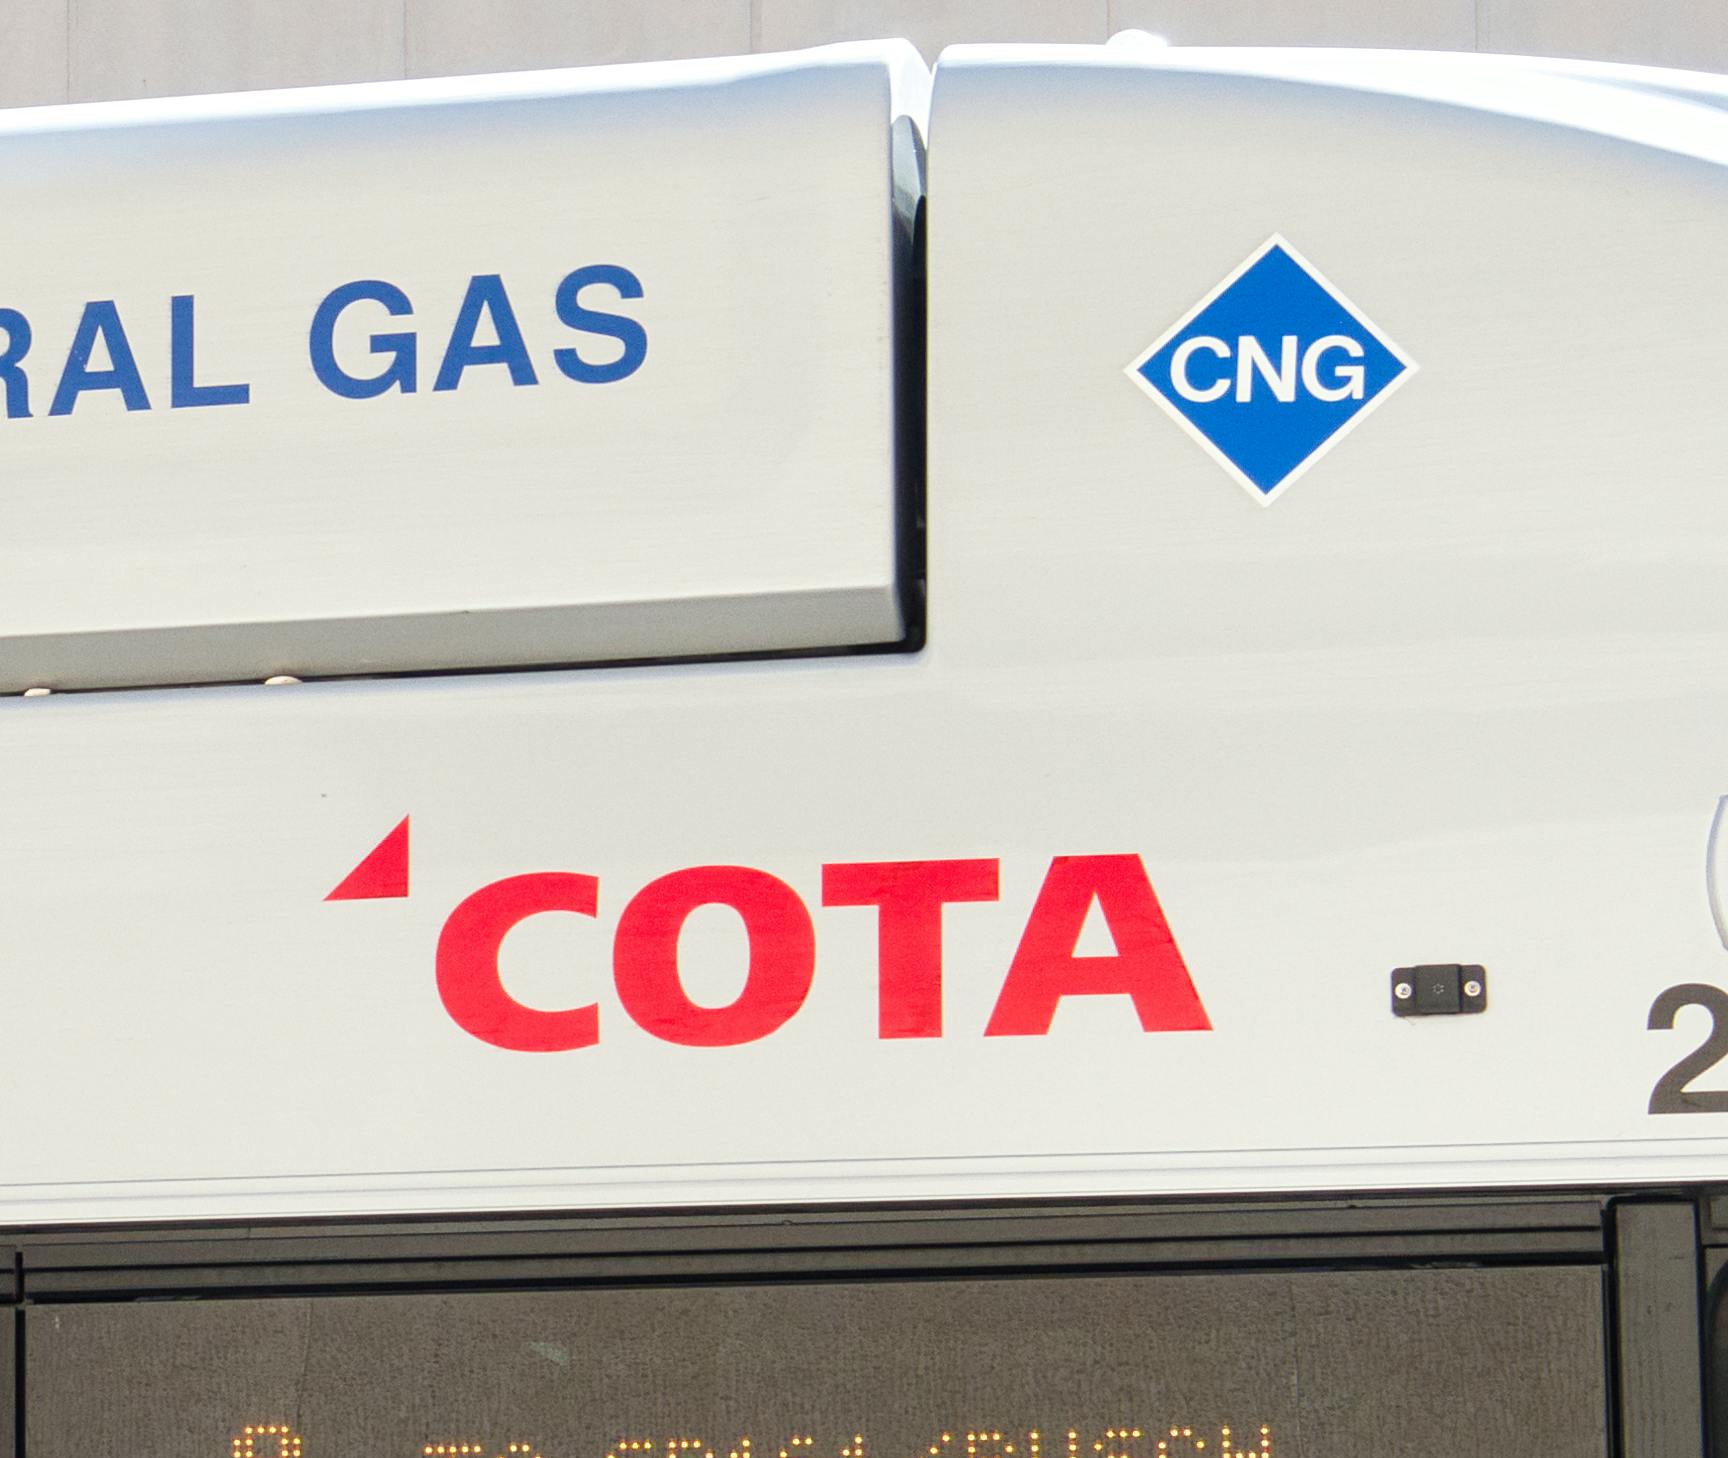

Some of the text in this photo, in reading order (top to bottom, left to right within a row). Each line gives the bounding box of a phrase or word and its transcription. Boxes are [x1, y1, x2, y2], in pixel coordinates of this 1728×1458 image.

[310, 266, 646, 399] GAS
[1170, 334, 1366, 403] CNG
[435, 853, 1213, 1053] COTA
[1647, 984, 1728, 1114] 2
